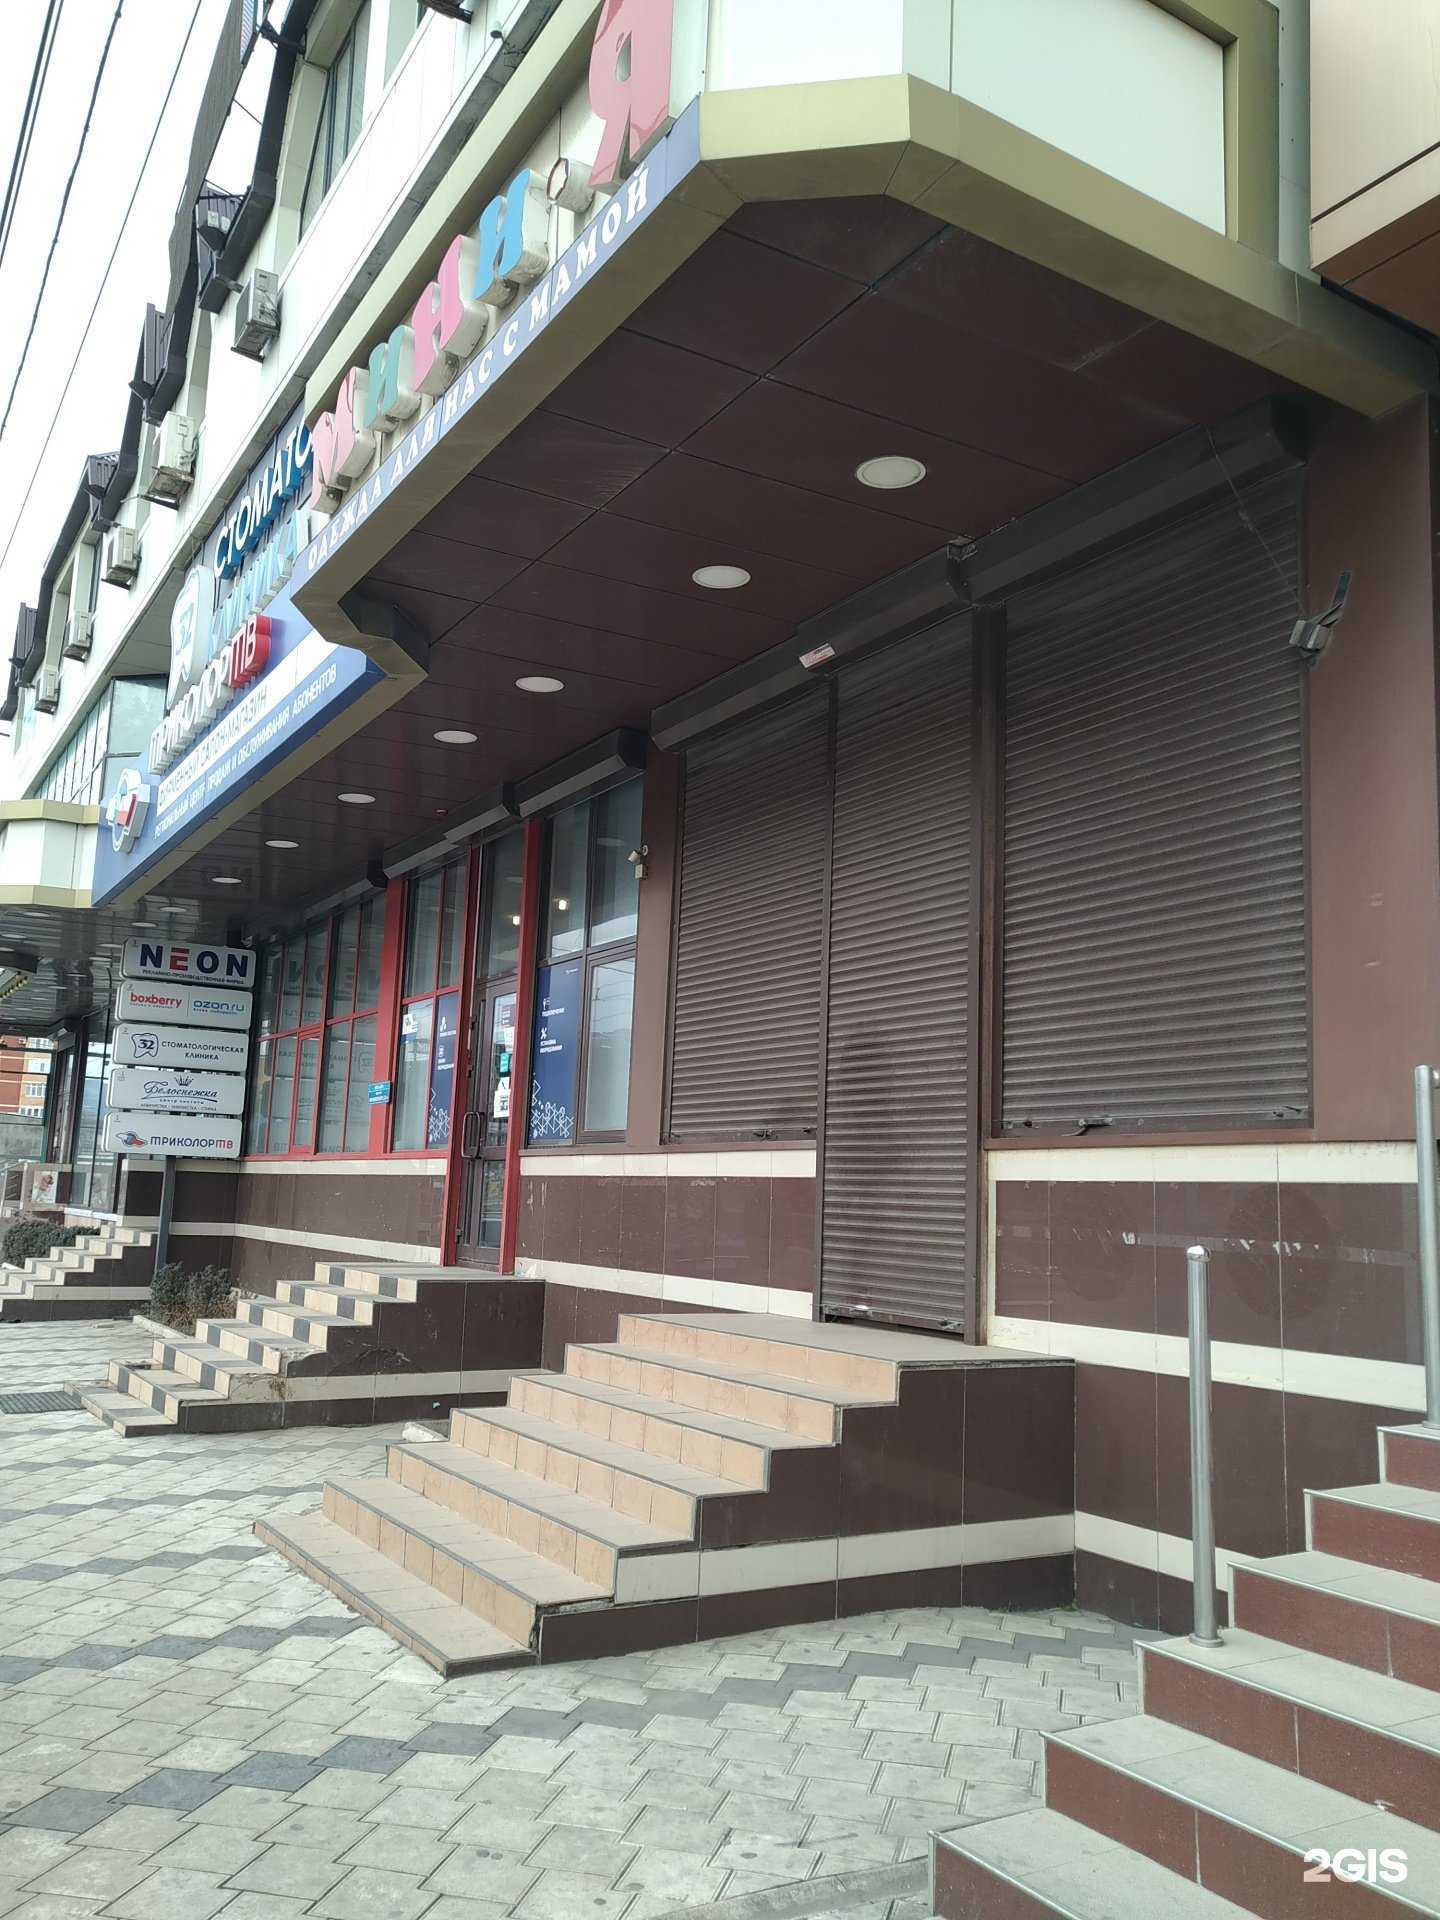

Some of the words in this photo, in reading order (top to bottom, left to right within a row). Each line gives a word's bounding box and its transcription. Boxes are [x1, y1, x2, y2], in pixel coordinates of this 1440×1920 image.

[308, 481, 382, 571] ОДЕЖДА
[391, 417, 437, 485] ДЛЯ
[443, 350, 494, 424] НАС
[502, 319, 519, 357] С
[528, 167, 650, 332] МАМОЙ
[214, 422, 313, 578] СТОМАТО
[292, 663, 337, 718] АБОНЕНТОВ
[140, 943, 249, 978] NEON
[130, 992, 182, 1008] boxberry
[138, 1039, 156, 1050] 32
[161, 1041, 244, 1054] СТОМАТОЛОГИЧЕСКАЯ
[185, 1053, 219, 1061] КЛИНИКА
[143, 1081, 218, 1098] Белоснежка
